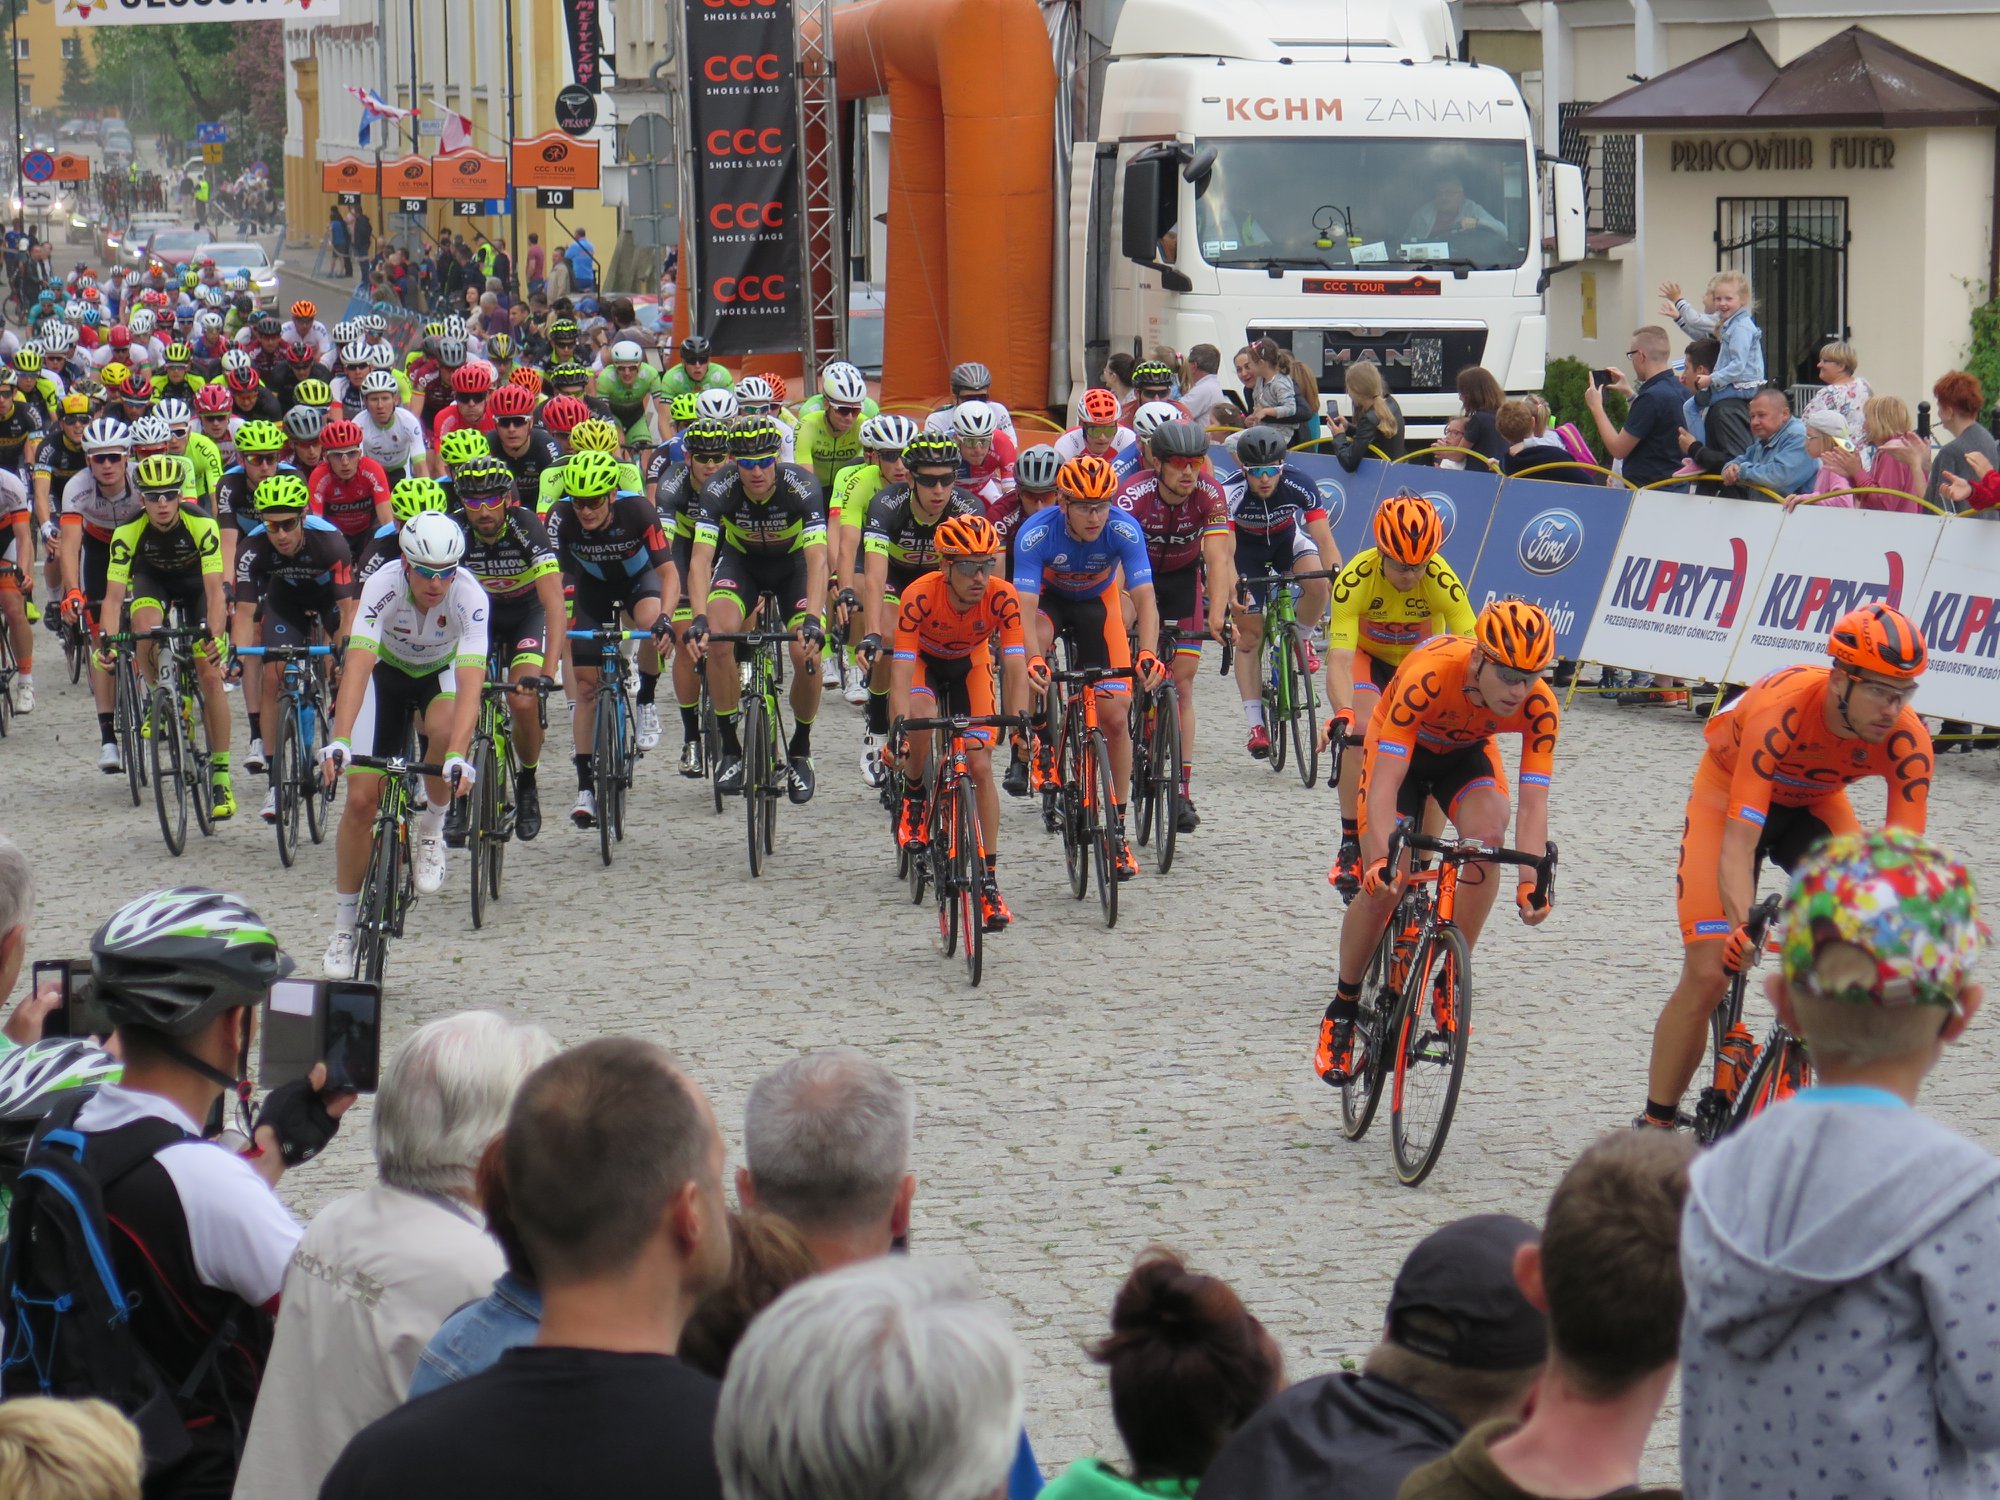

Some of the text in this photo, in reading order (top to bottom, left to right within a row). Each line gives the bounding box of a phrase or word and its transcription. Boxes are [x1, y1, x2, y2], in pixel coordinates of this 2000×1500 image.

[704, 11, 776, 21] SHOES & BAGS
[704, 54, 779, 82] CCC
[706, 85, 779, 95] SHOES & BAGS
[1226, 97, 1492, 124] KGHM ZANAM
[706, 128, 782, 155] CCC
[1670, 135, 1895, 172] PRACOWNIA FUTER
[534, 165, 575, 173] CCC TOUR
[709, 159, 782, 169] SHOES & BAGS
[344, 195, 355, 203] 75
[406, 201, 420, 211] 50
[461, 203, 476, 214] 25
[546, 192, 563, 205] 10
[709, 202, 783, 229] CCC
[712, 233, 783, 243] SHOES & BAGS
[712, 274, 785, 303] CCC
[1323, 281, 1385, 292] CCC TOUR
[715, 306, 785, 316] SHOES & BAGS
[1324, 348, 1412, 366] MAN
[1024, 529, 1044, 547] Ford
[1114, 522, 1136, 539] Ford
[1527, 517, 1573, 564] Ford
[236, 549, 258, 583] Merx
[1334, 560, 1373, 603] CCC
[1425, 560, 1465, 603] CCC
[1611, 555, 1736, 621] KUPRYT
[898, 594, 932, 633] CCC
[990, 590, 1021, 630] CCC
[1604, 614, 1664, 633] PRZEDSIĘBIORSTWO
[1687, 626, 1728, 642] GÓRNICZYCH
[1390, 671, 1442, 727] CCC
[1523, 693, 1558, 754] CCC
[1752, 707, 1801, 781] CCC
[1887, 730, 1930, 802] CCC
